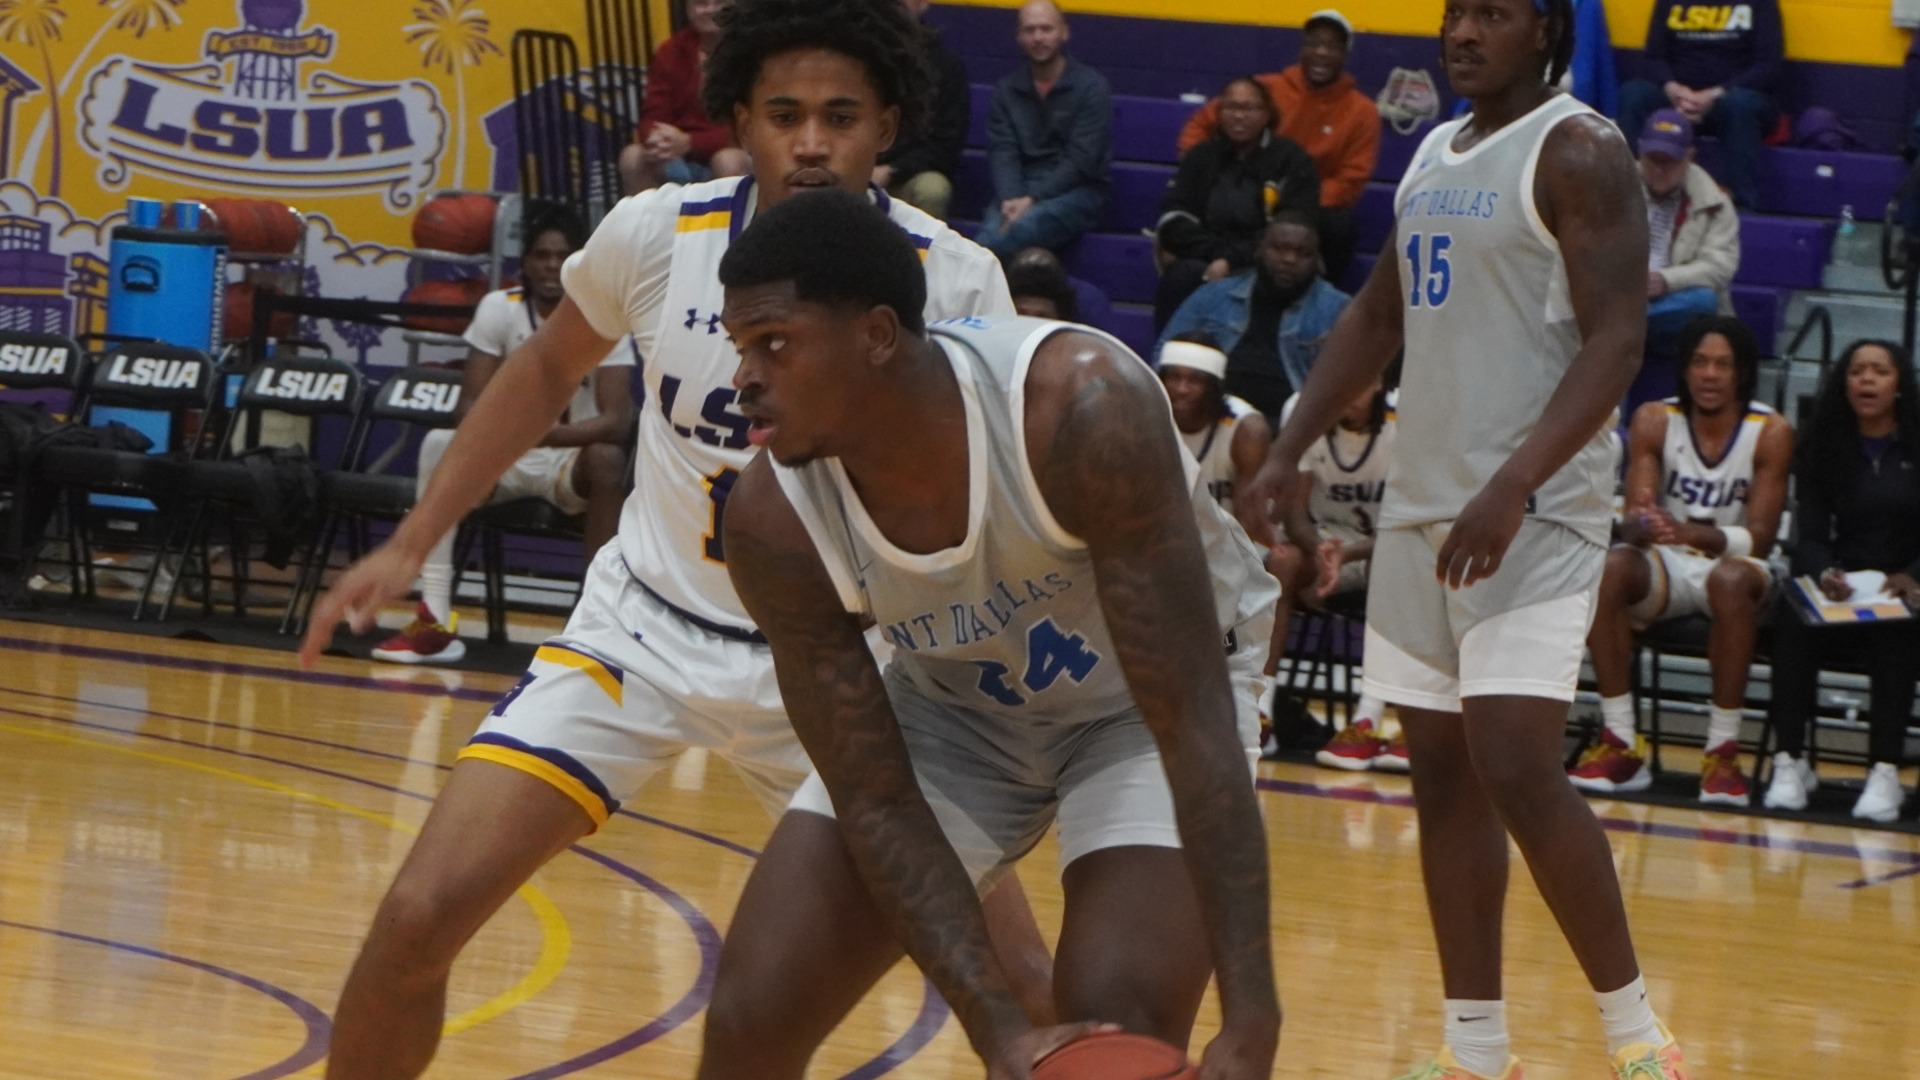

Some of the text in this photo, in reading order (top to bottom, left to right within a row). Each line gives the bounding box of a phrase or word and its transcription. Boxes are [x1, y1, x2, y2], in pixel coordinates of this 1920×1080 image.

[1667, 5, 1752, 31] LSUA
[108, 77, 415, 160] LSUA
[1428, 190, 1498, 219] DALLAS
[1406, 233, 1453, 309] 15
[0, 343, 68, 374] SUA
[108, 354, 201, 388] LSUA
[255, 367, 348, 400] LSUA
[388, 380, 462, 412] LSU
[1666, 470, 1748, 508] LSUA
[887, 572, 1072, 651] NT DALLAS
